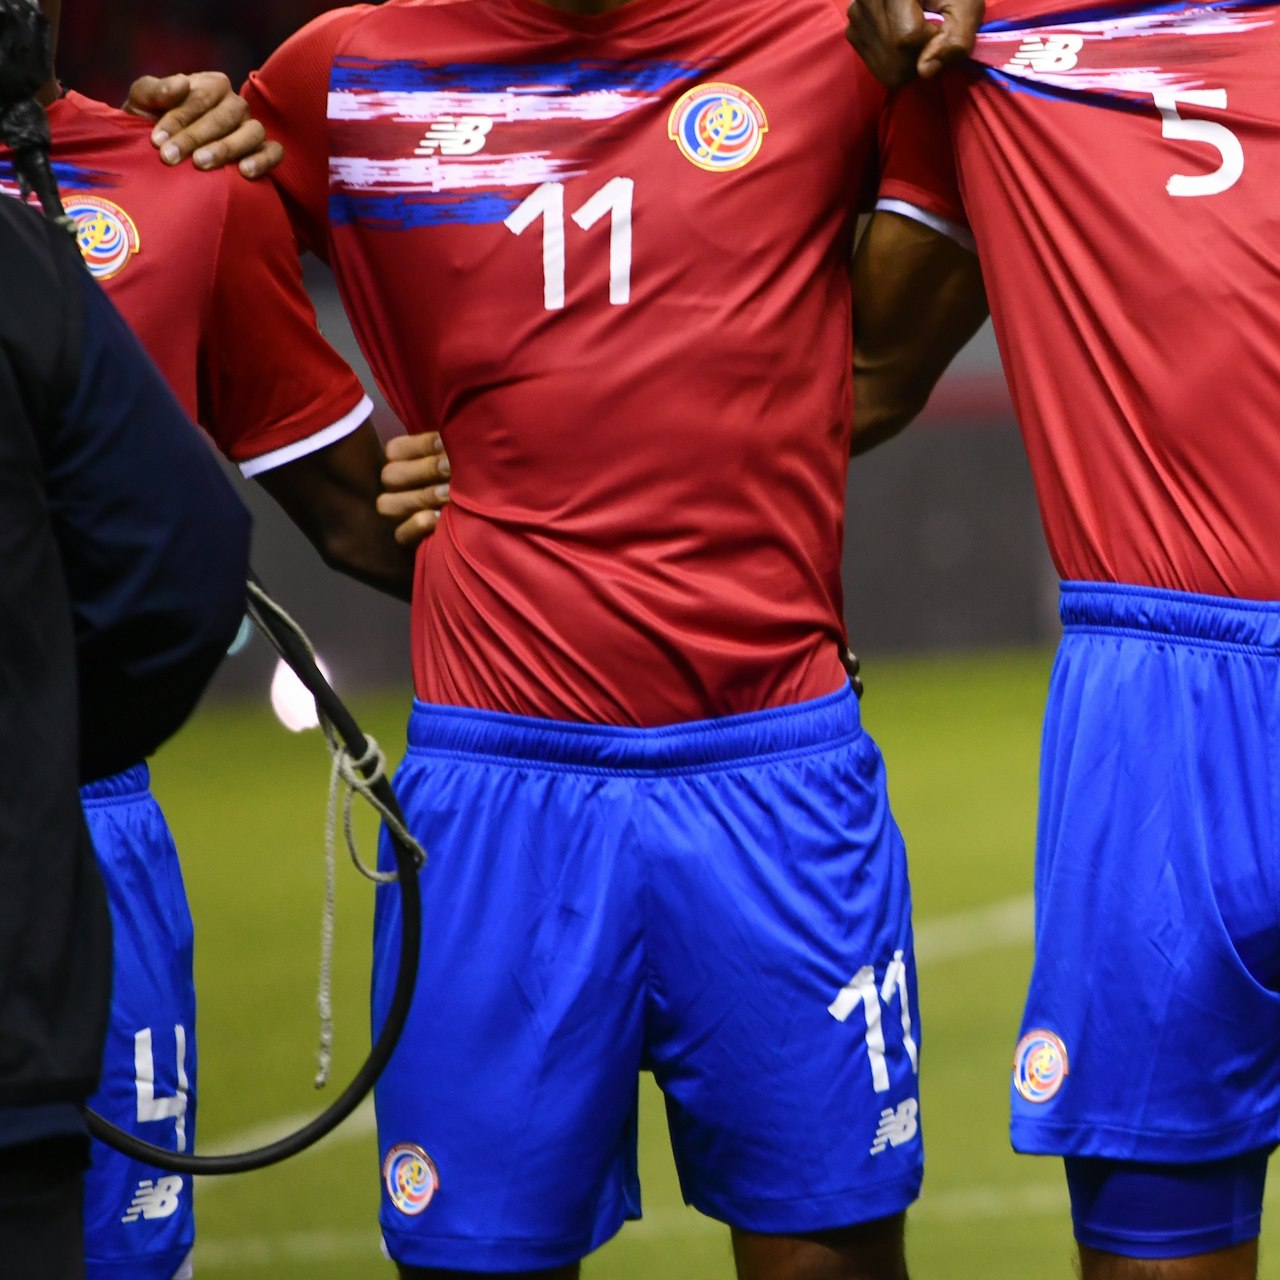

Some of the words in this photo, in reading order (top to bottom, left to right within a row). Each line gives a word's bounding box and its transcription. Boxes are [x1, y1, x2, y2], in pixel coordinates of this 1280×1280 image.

[1151, 88, 1245, 197] 5
[503, 176, 634, 310] 11
[827, 949, 918, 1093] 11
[133, 1023, 189, 1153] 4
